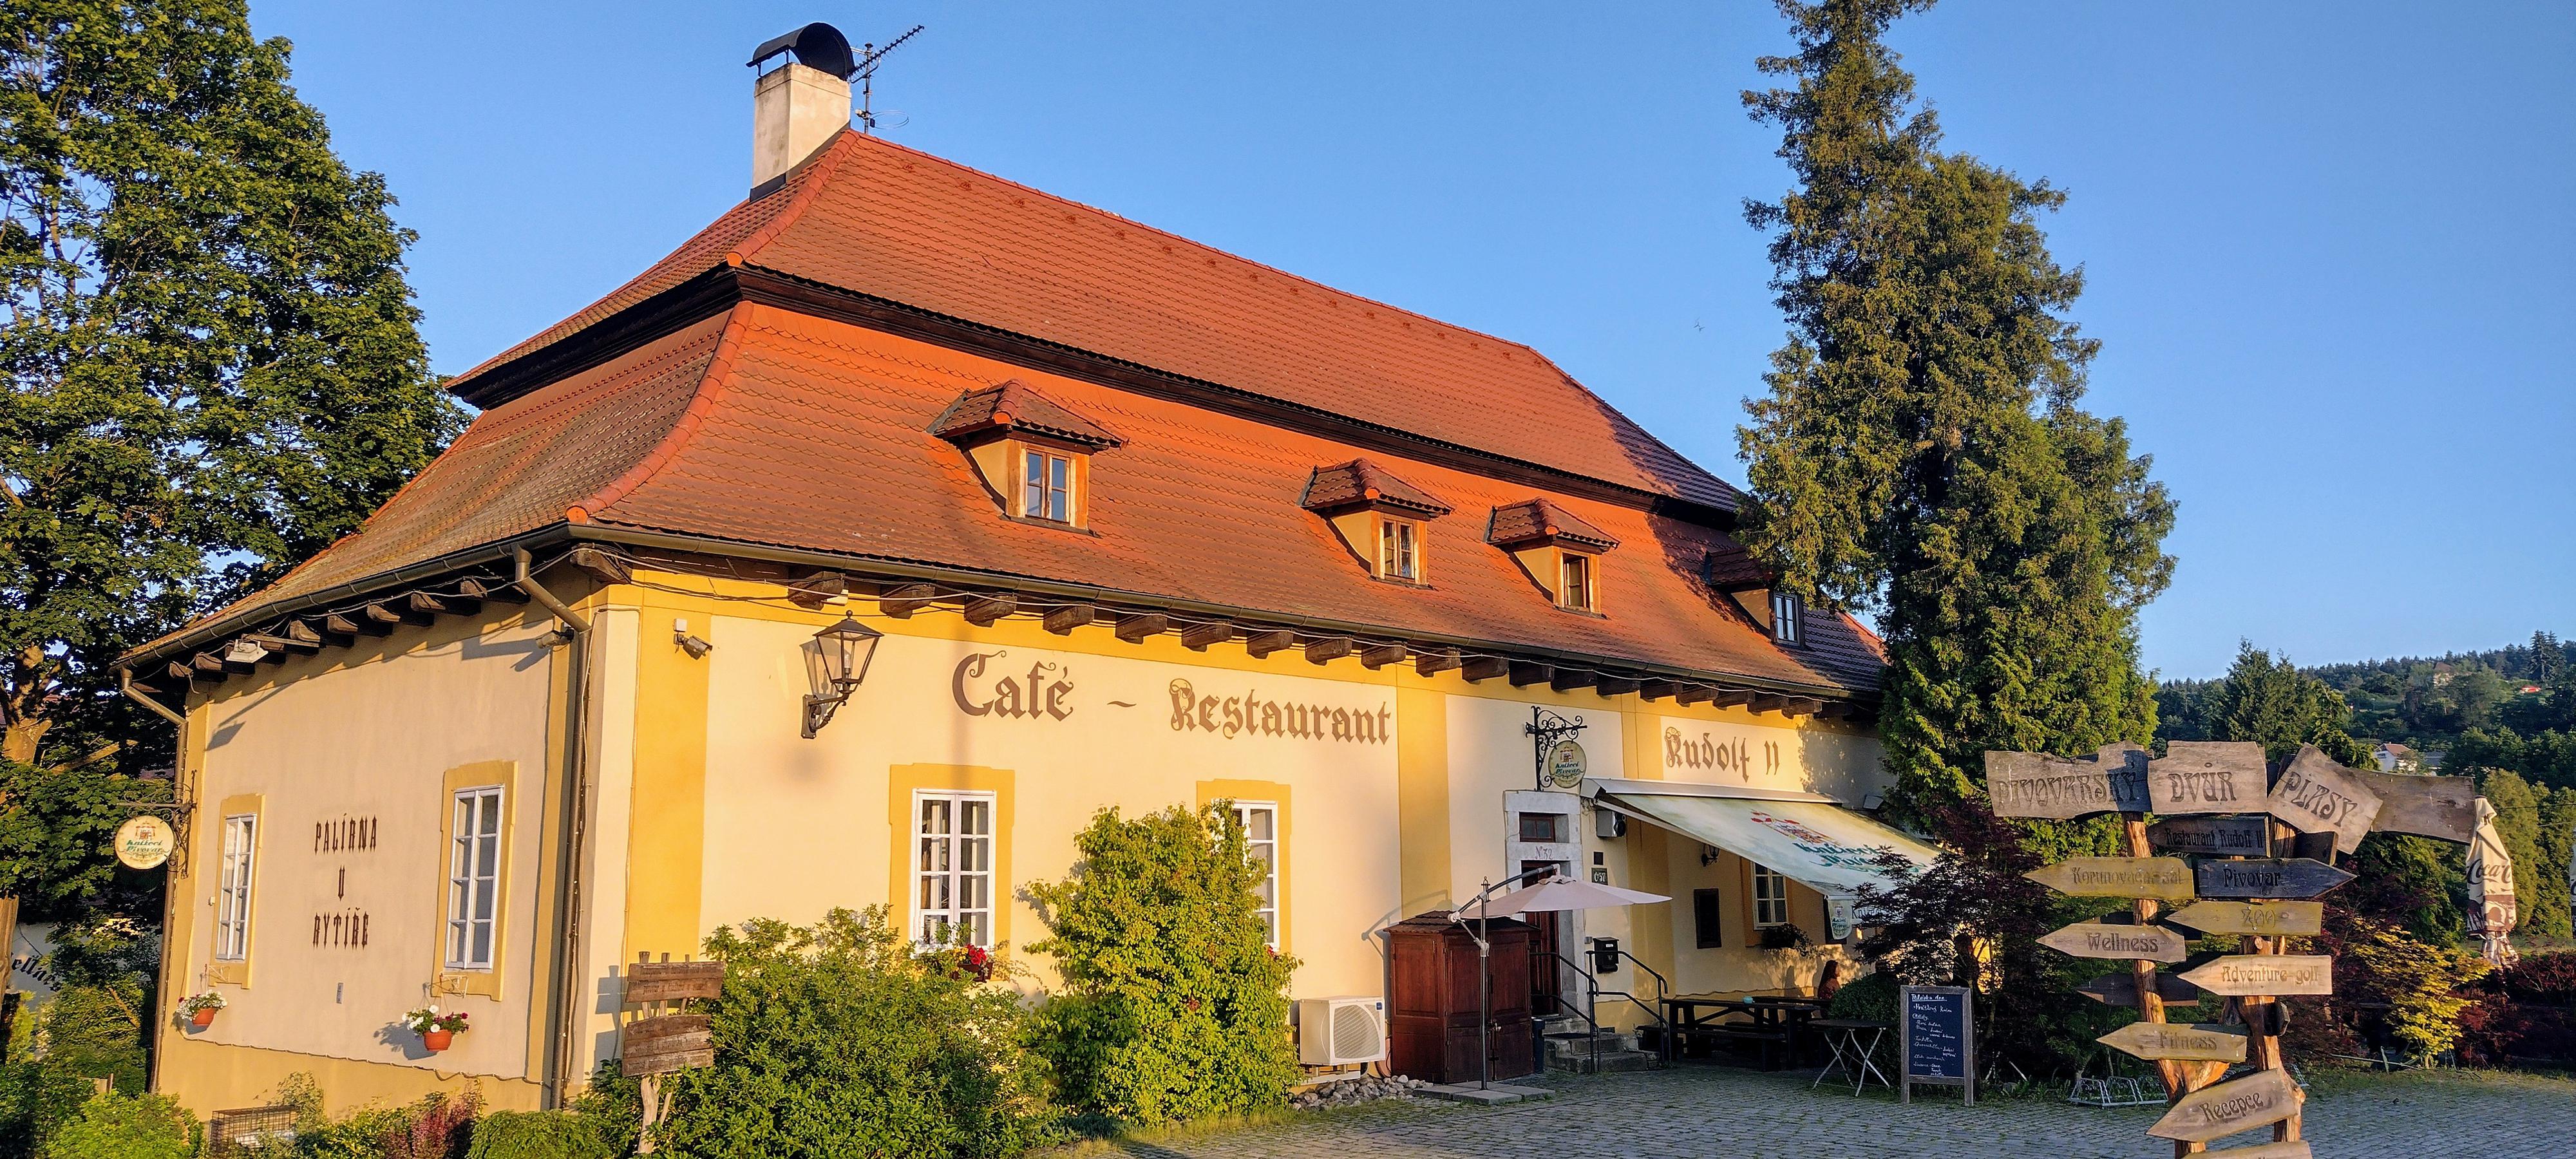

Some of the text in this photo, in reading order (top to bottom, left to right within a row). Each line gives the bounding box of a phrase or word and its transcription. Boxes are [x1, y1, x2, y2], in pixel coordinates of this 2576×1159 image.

[952, 650, 1074, 722] Café
[1169, 678, 1392, 746] Restaurant
[1664, 726, 1750, 783] Rudolf
[2168, 762, 2237, 803] DVŮR
[2278, 771, 2358, 827] PLASY
[314, 812, 377, 856] PALÍRNA
[2164, 828, 2215, 847] Restaurant
[2219, 829, 2253, 848] Rudolf
[337, 864, 346, 902] U
[2223, 868, 2281, 887] Pivovar
[2467, 858, 2512, 885] Coca-C
[312, 907, 369, 950] RYTÍŘE
[2086, 932, 2159, 952] Wellness
[2159, 1032, 2218, 1051] Fitness
[2199, 1092, 2264, 1122] Recepce
